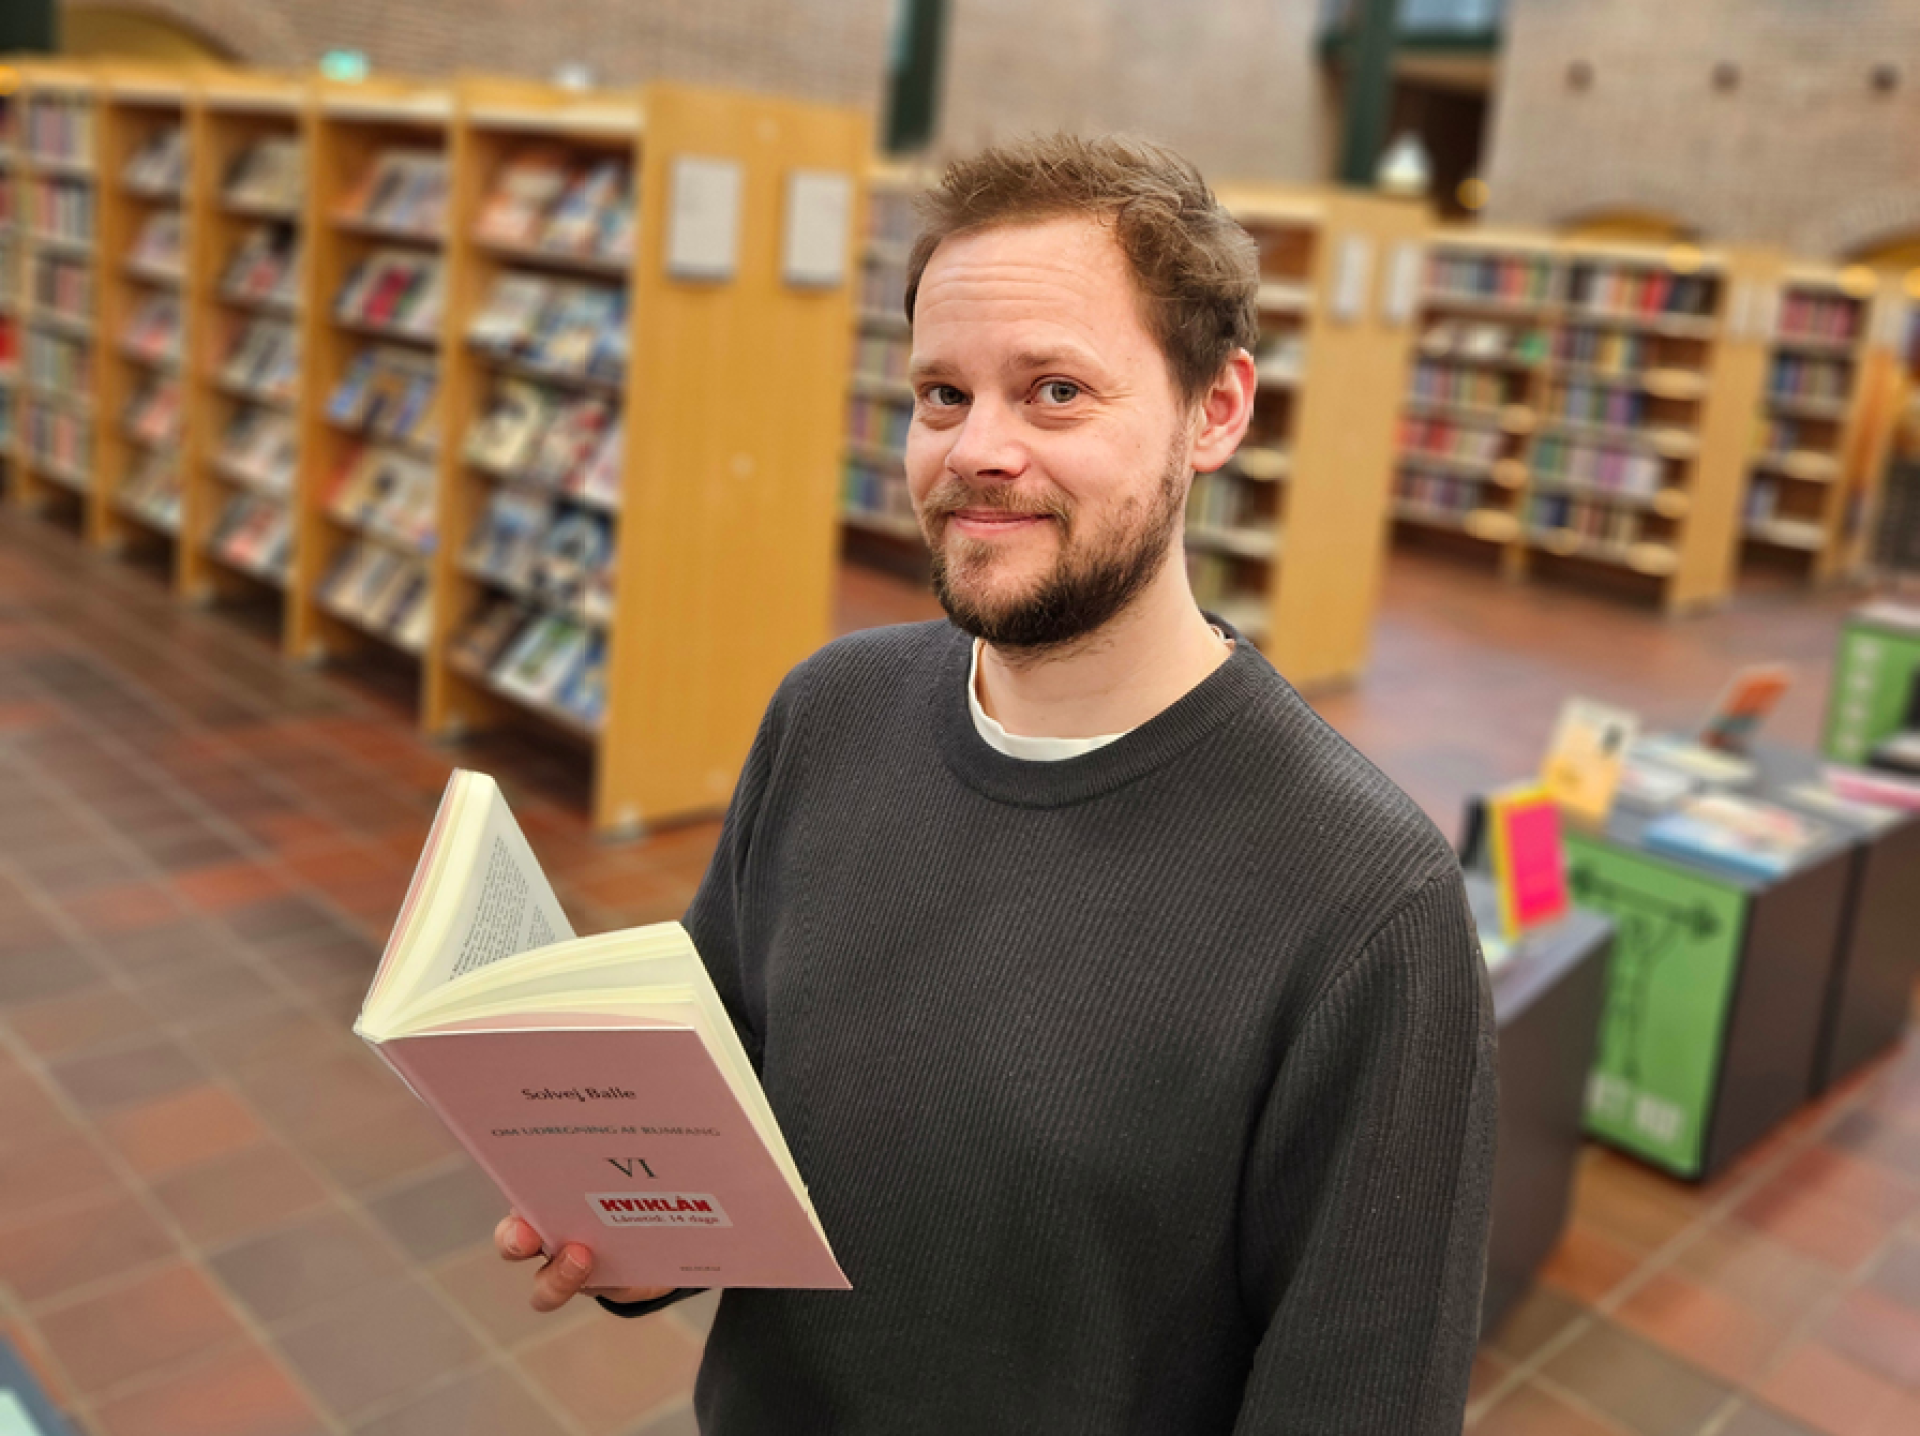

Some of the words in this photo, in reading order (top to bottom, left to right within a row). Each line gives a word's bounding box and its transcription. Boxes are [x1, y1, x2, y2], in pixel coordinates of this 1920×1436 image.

[521, 1087, 585, 1102] Solvej
[585, 1087, 636, 1100] Balle
[491, 1128, 519, 1137] OM
[522, 1126, 617, 1136] UDREGNING
[621, 1126, 637, 1135] AF
[641, 1126, 721, 1137] RUMFANG
[603, 1157, 658, 1178] VI
[598, 1195, 714, 1213] KVIKLÅN
[669, 1214, 685, 1223] 14
